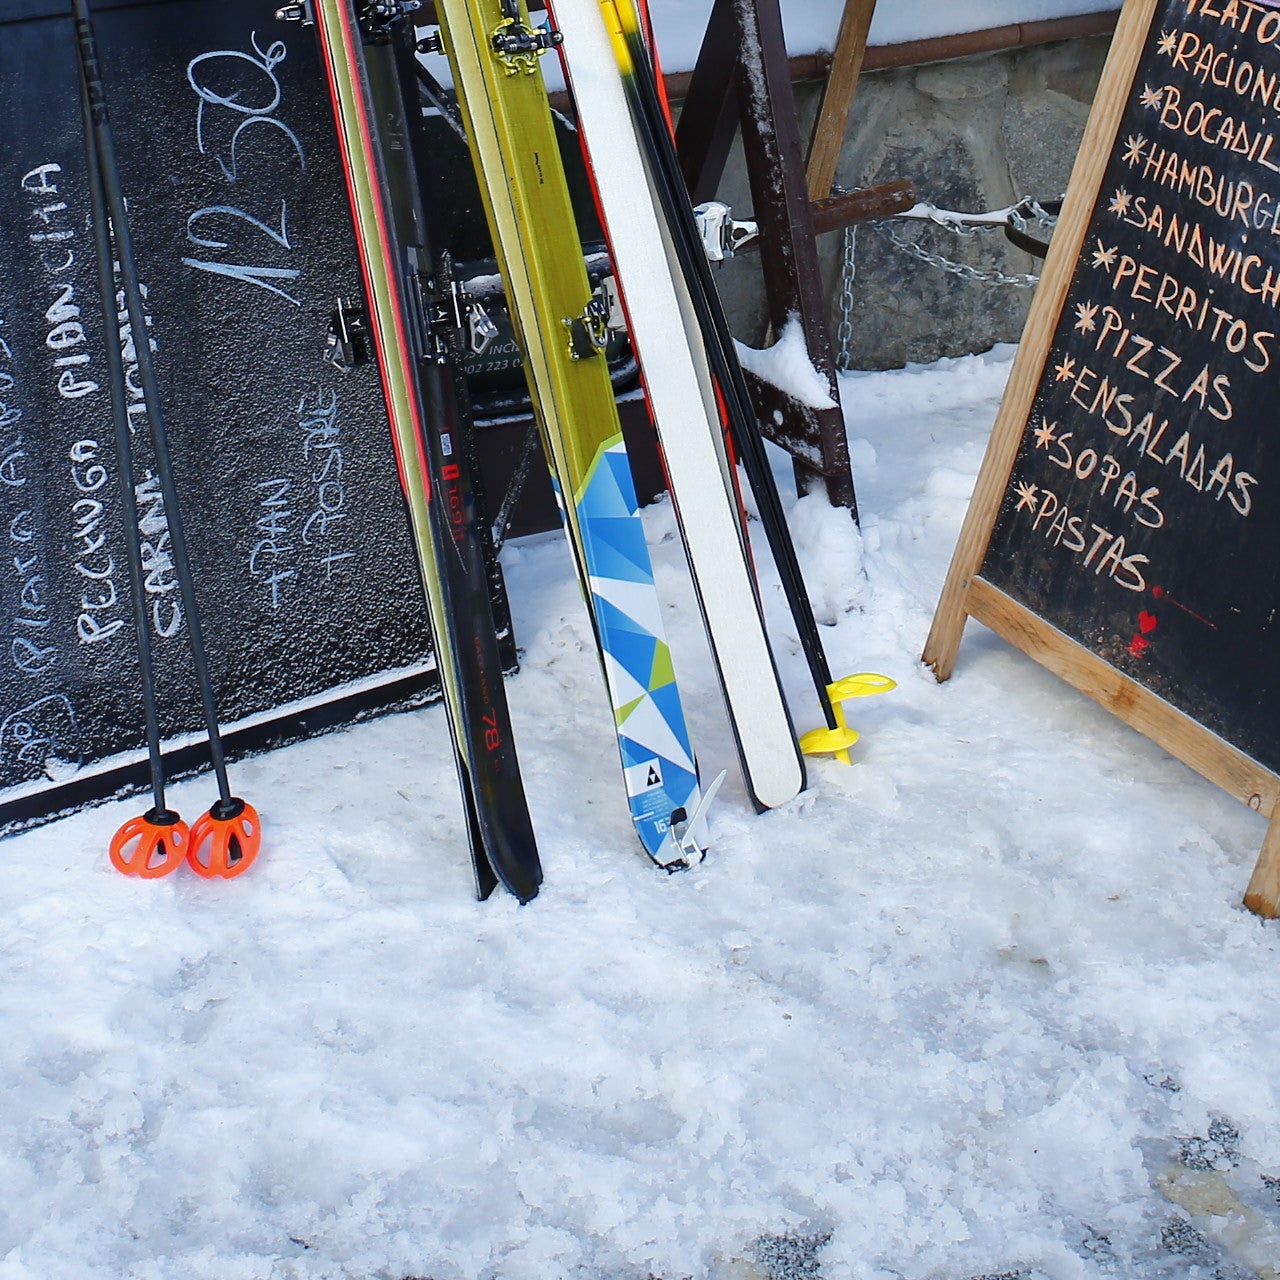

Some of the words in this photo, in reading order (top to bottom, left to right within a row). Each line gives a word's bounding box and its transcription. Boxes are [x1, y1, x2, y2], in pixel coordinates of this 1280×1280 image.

[1048, 432, 1165, 528] SOPAS
[1070, 365, 1259, 517] ENSALADAS
[1031, 488, 1150, 593] PASTAS
[482, 707, 501, 751] 78
